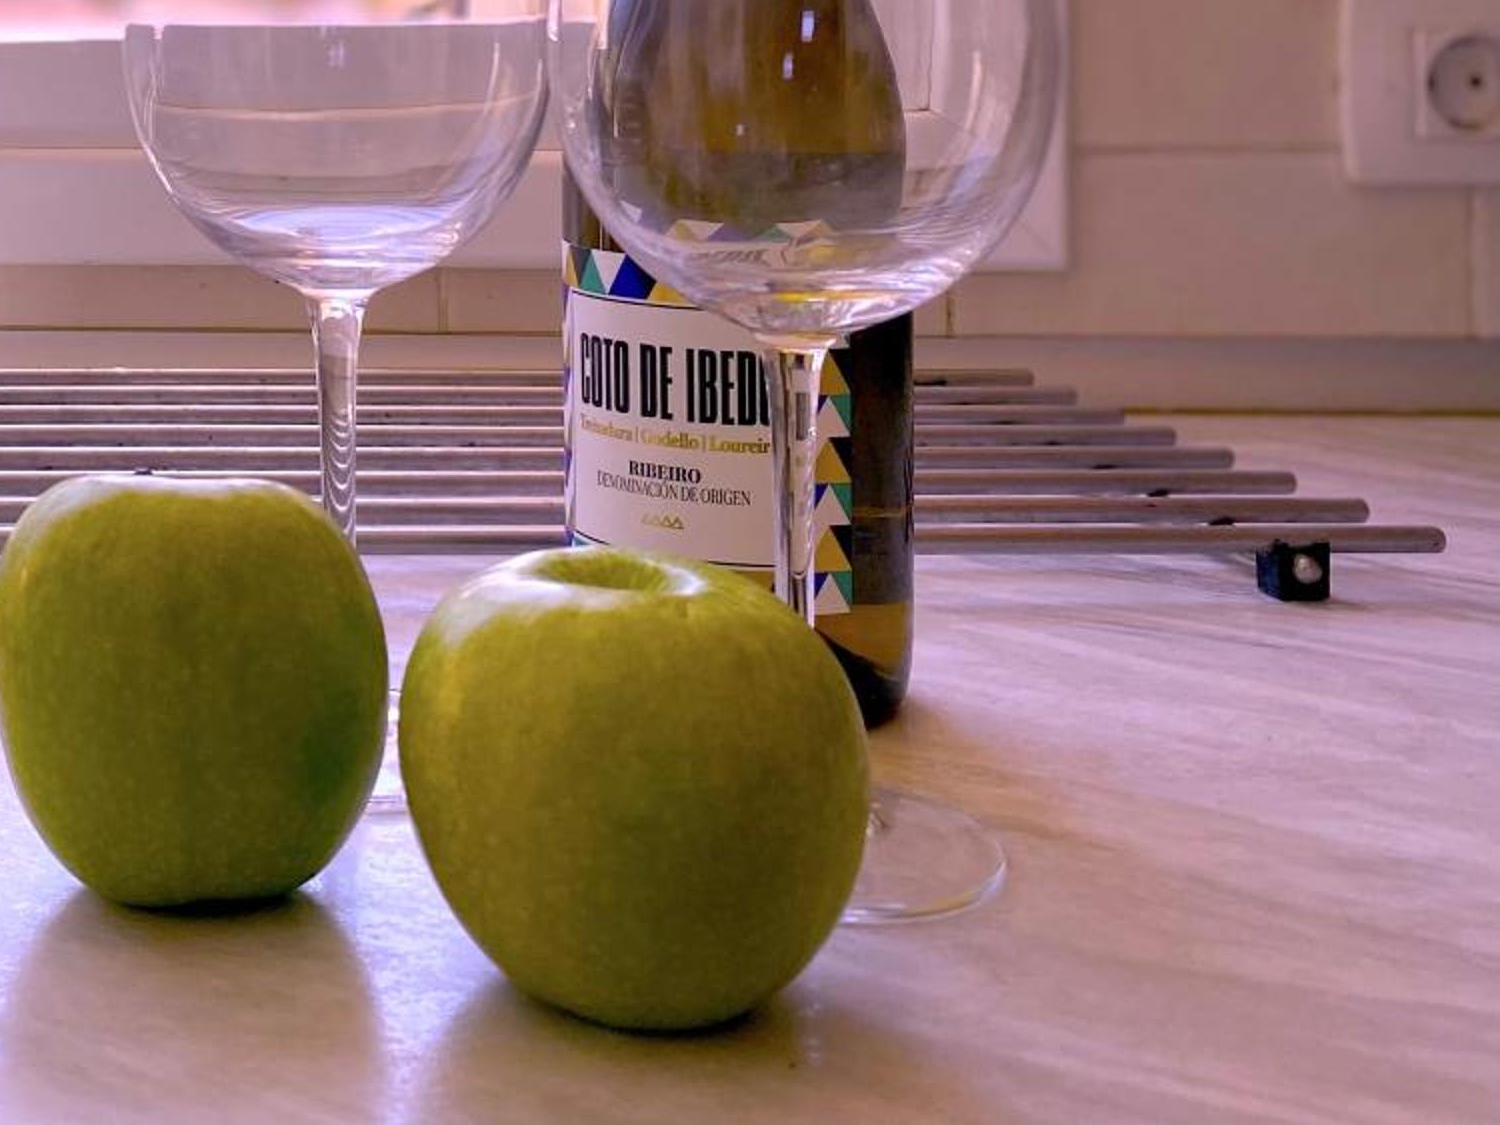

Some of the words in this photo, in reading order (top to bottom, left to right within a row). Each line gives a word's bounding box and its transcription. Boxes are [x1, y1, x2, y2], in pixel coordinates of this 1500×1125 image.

[581, 333, 629, 413] COTO
[640, 343, 673, 420] DE
[597, 470, 678, 501] DENOMINACIÓN
[680, 486, 699, 502] DE
[701, 488, 751, 506] ORIGEN
[629, 460, 701, 484] RIBEIRO
